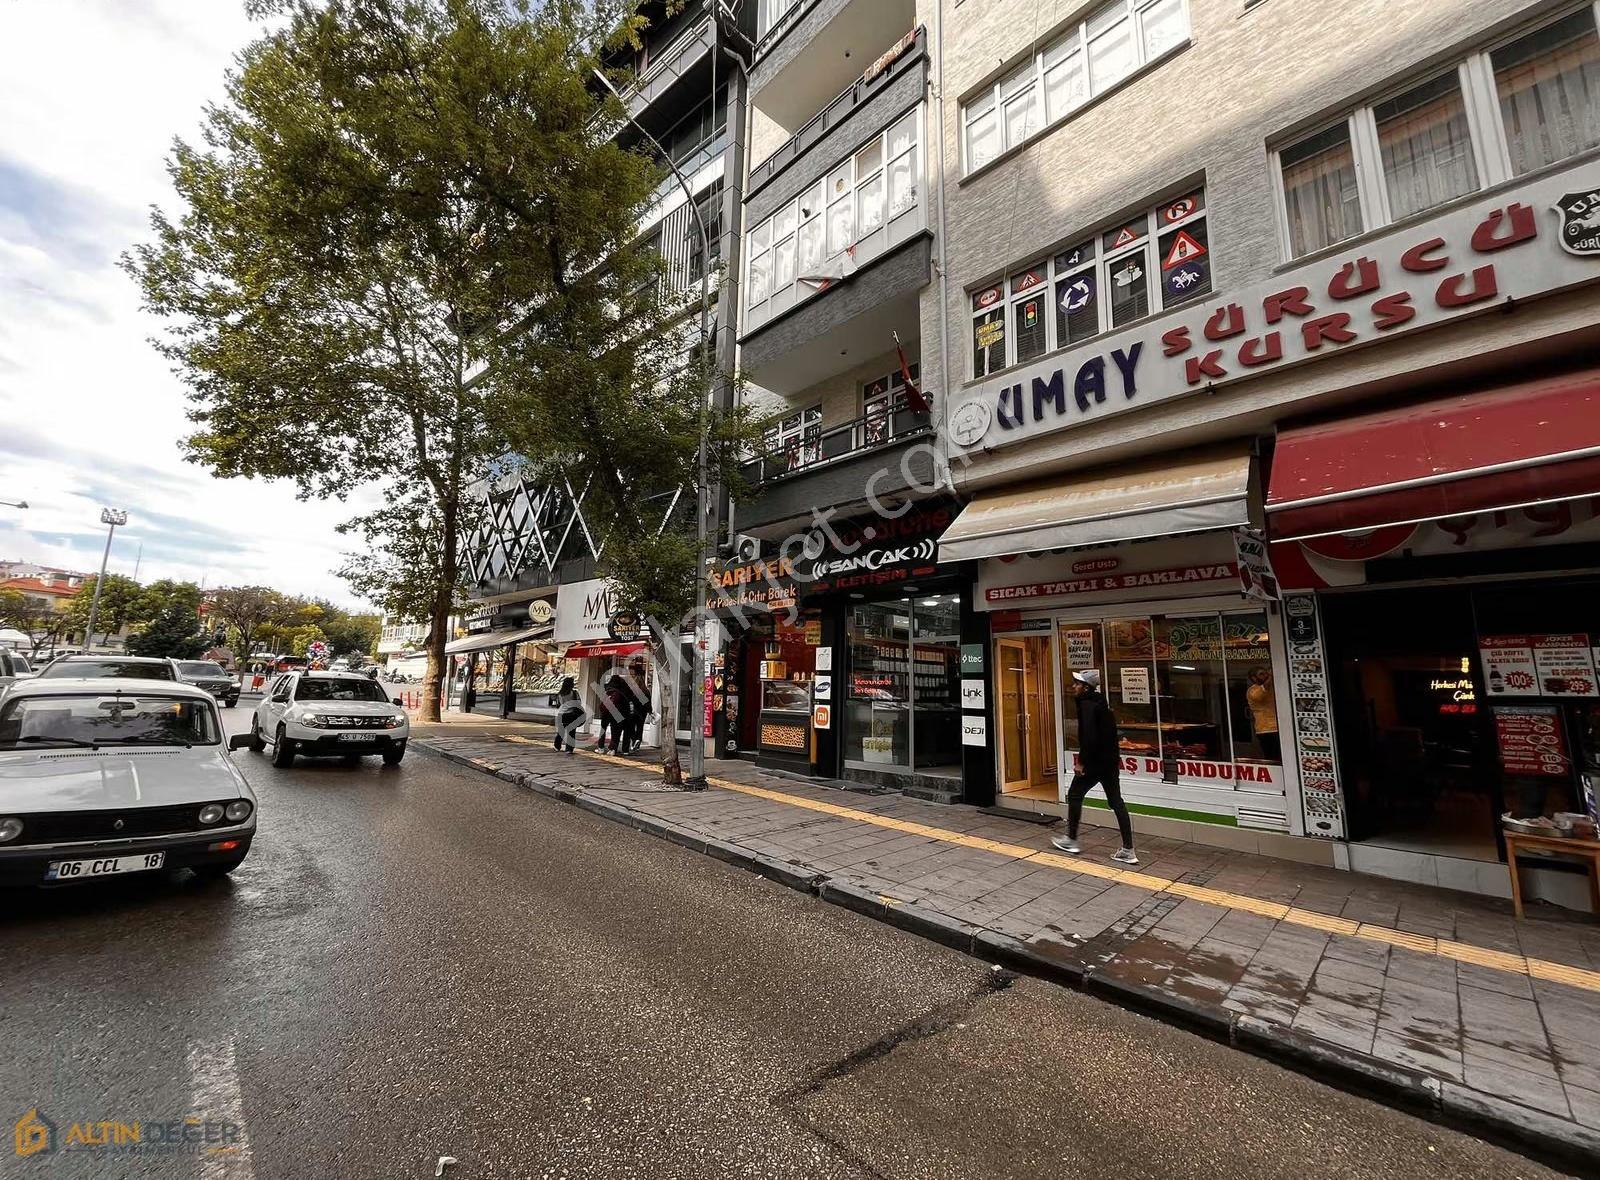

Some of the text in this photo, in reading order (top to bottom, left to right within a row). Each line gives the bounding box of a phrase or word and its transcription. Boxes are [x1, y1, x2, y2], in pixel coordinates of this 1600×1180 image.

[1161, 202, 1537, 357] SÜRÜCÜ
[1184, 264, 1497, 385] KURSU
[997, 341, 1144, 430] UMAY
[989, 585, 1038, 600] SICAK
[1042, 580, 1098, 595] TATLI
[1104, 577, 1118, 589] &
[1122, 566, 1232, 587] BAKLAVA
[60, 854, 159, 877] 06 CCL 18
